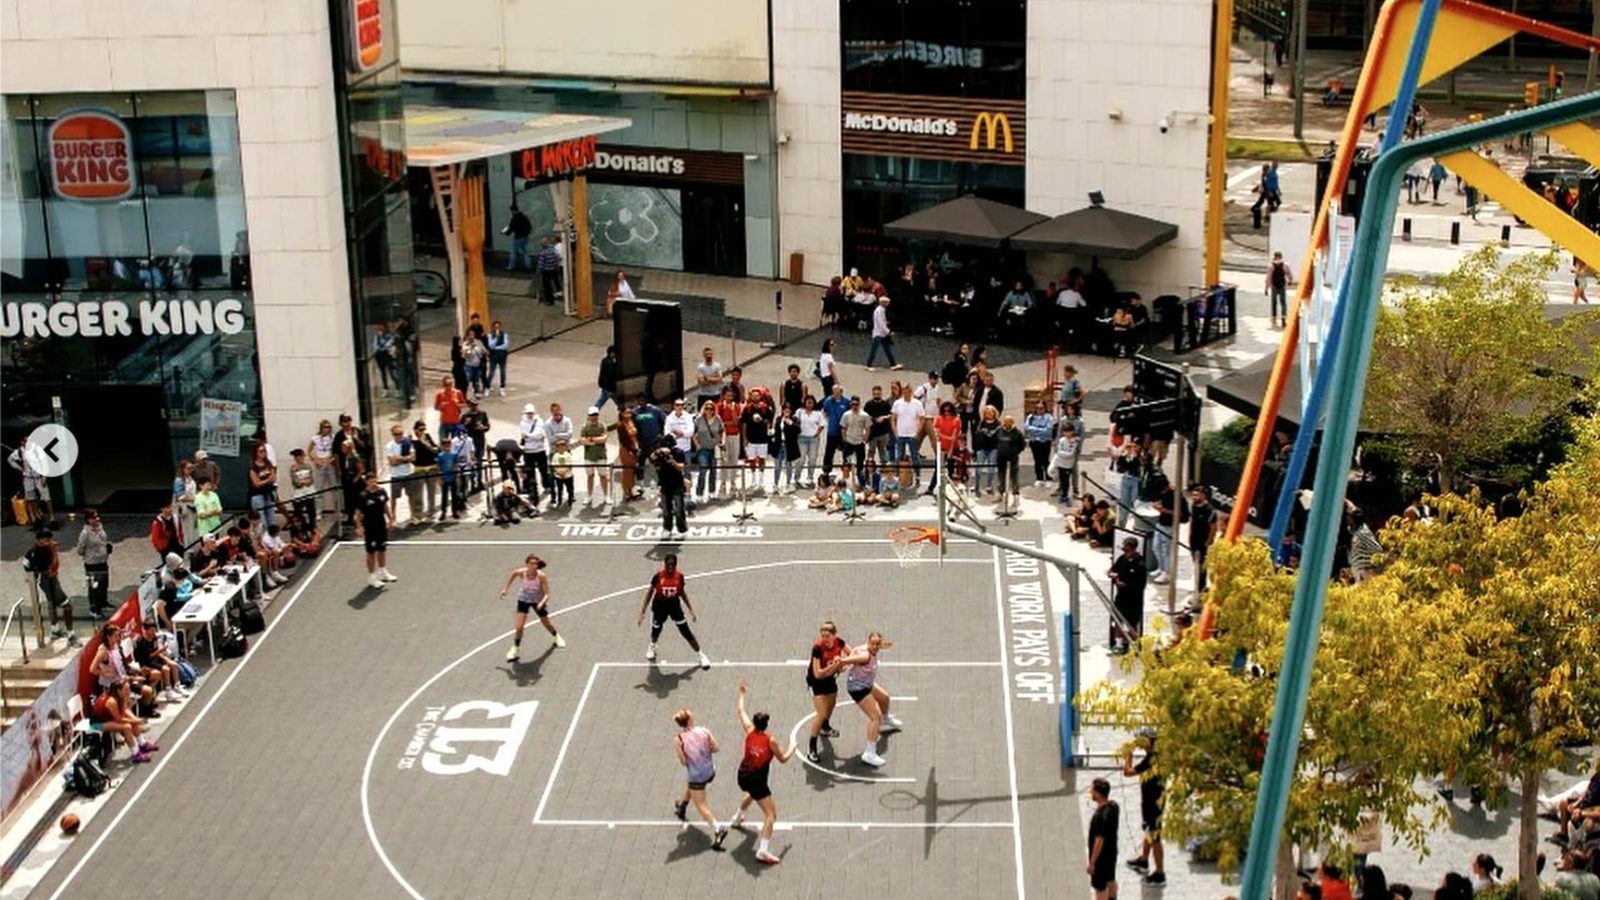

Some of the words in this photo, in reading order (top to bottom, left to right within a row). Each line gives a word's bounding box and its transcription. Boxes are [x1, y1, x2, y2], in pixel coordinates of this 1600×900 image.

[844, 112, 958, 136] McDonald's
[53, 141, 127, 159] BURGER
[56, 159, 129, 183] KING
[592, 152, 685, 174] Donald's
[0, 301, 132, 338] URGER
[139, 299, 245, 335] KING
[558, 523, 622, 536] TIME
[1008, 581, 1046, 624] WORK
[1012, 629, 1051, 667] PAYS
[1015, 672, 1055, 704] OFF
